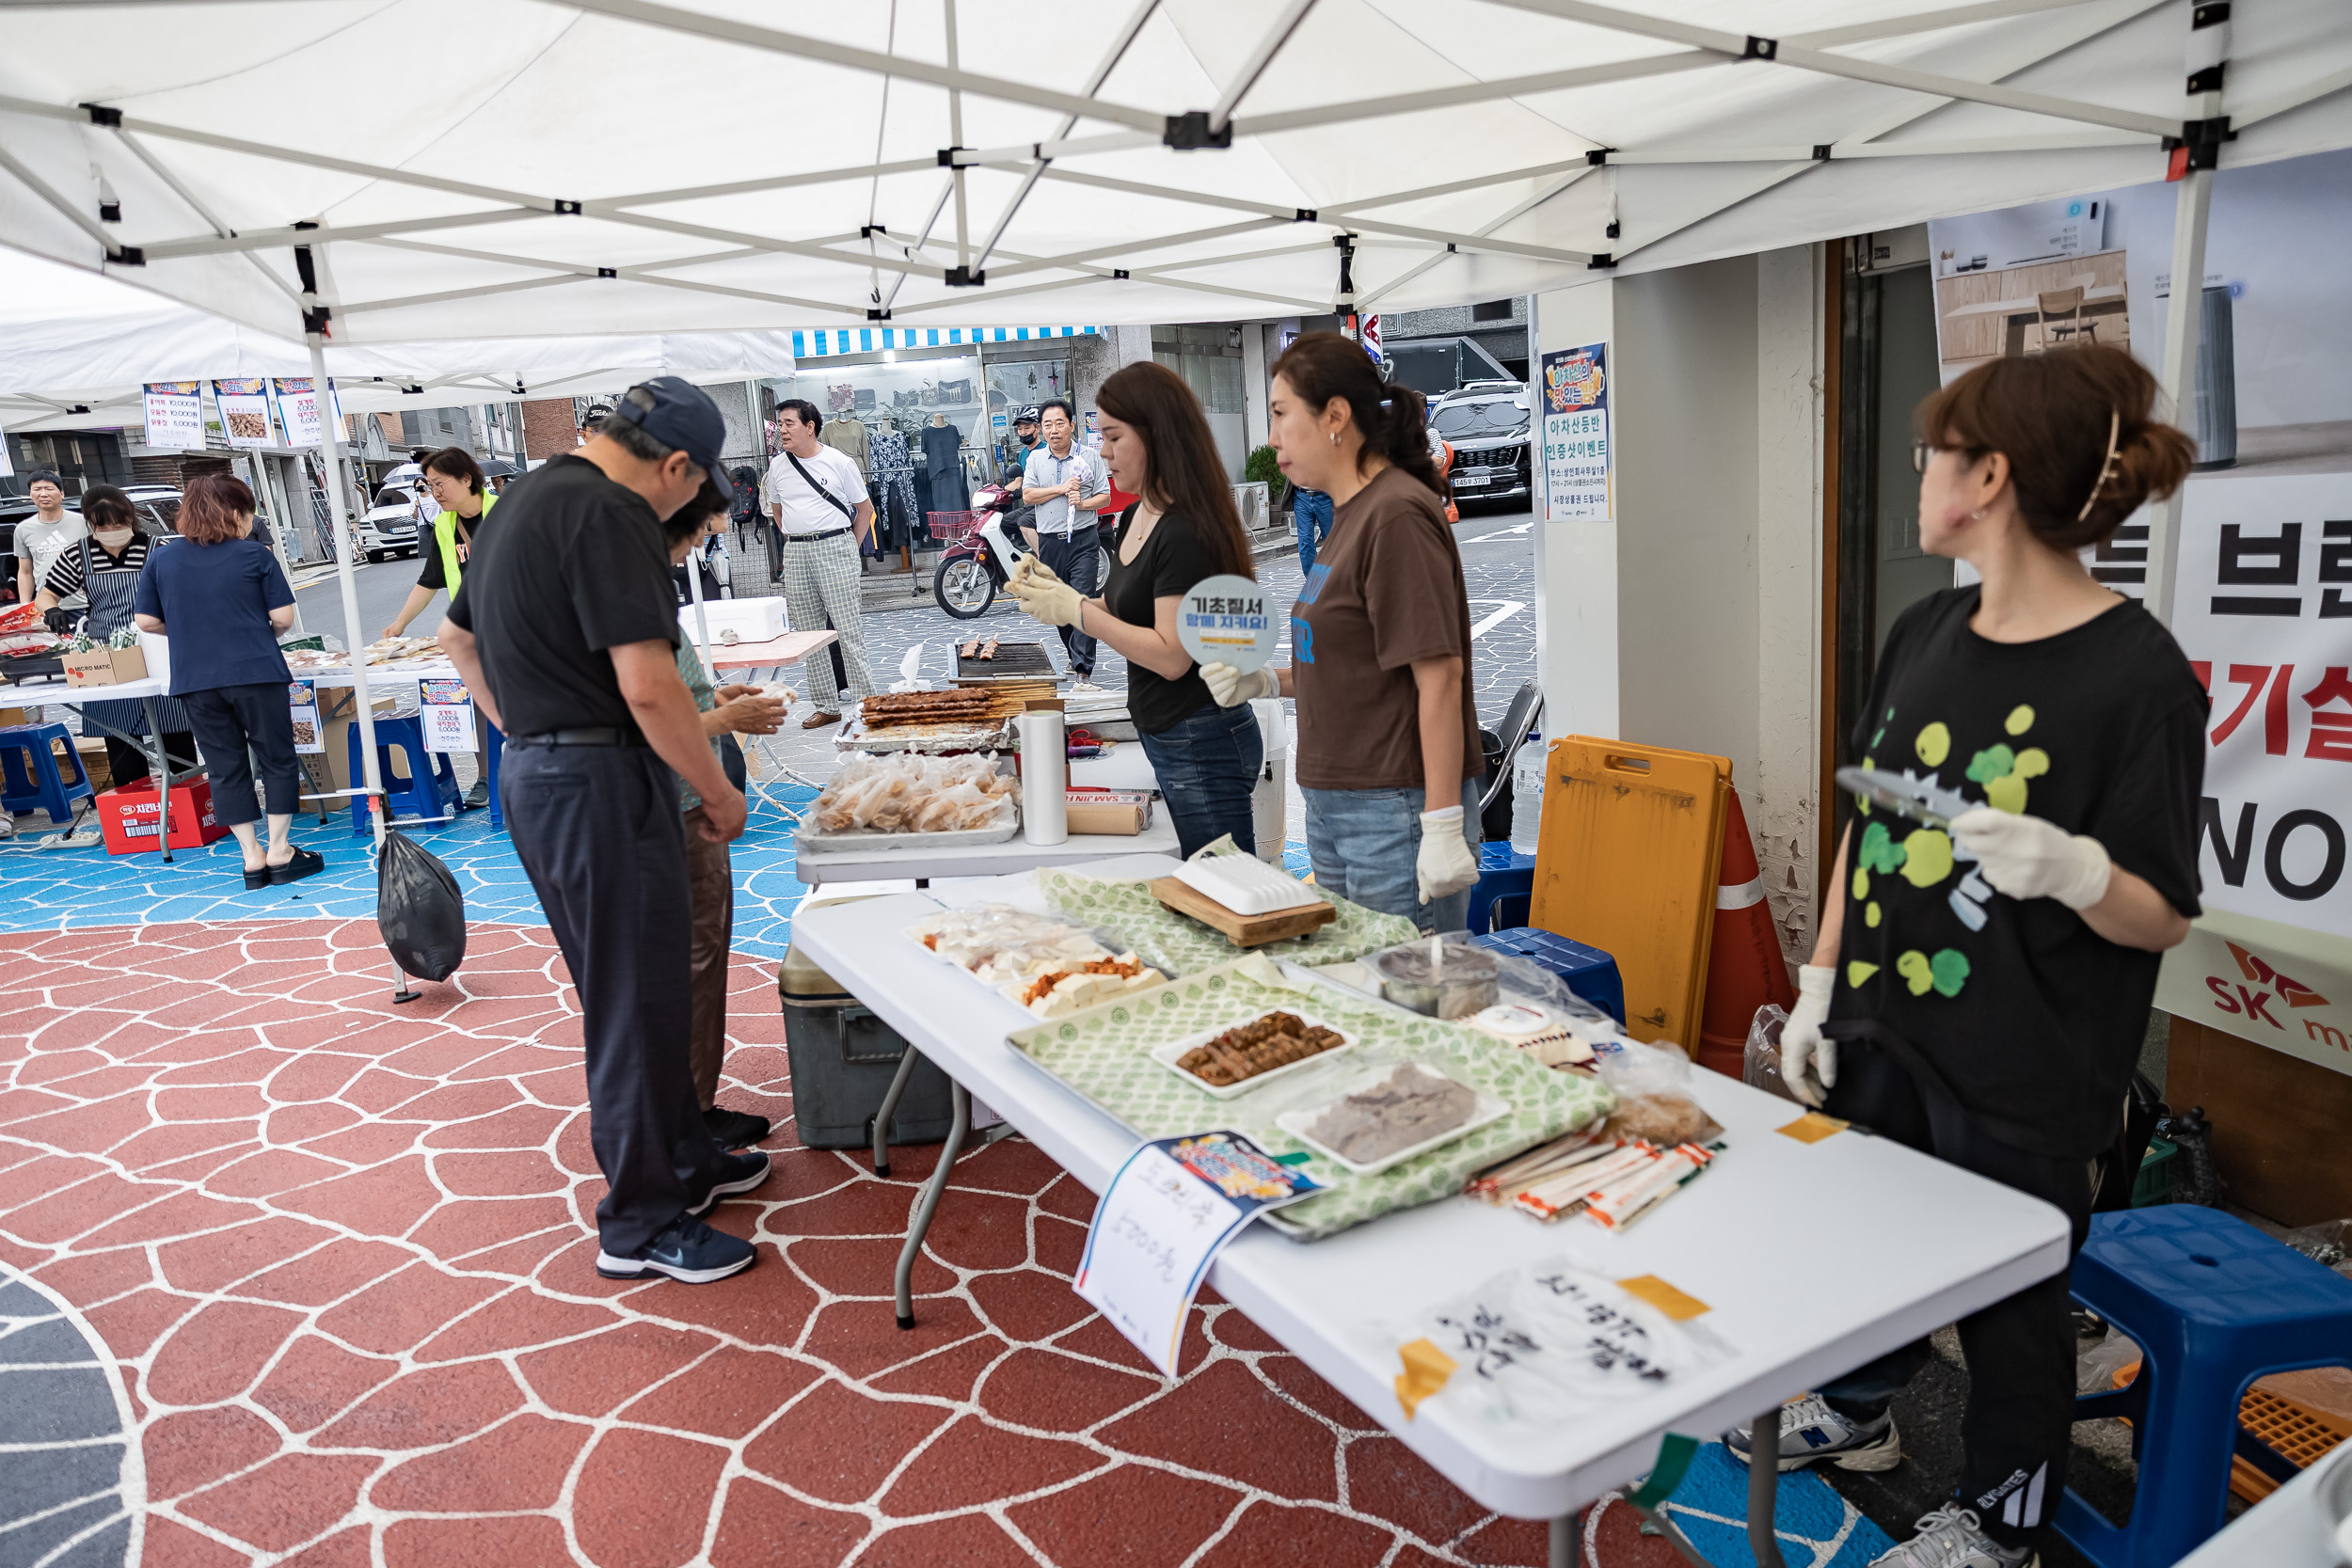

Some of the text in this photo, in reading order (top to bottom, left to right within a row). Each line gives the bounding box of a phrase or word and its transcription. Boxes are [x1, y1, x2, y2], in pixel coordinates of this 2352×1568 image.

[1554, 362, 1590, 387] 아차산의
[169, 399, 198, 409] 10,000원
[1554, 387, 1581, 405] 맛있는
[170, 409, 198, 419] 10,000원
[297, 404, 318, 413] 5,000
[1550, 415, 1600, 436] 아차산등반
[1554, 495, 1581, 504] 시장상품권
[1190, 596, 1263, 615] 기초질서
[1185, 612, 1216, 628] 함께
[2204, 974, 2352, 1053] SK m
